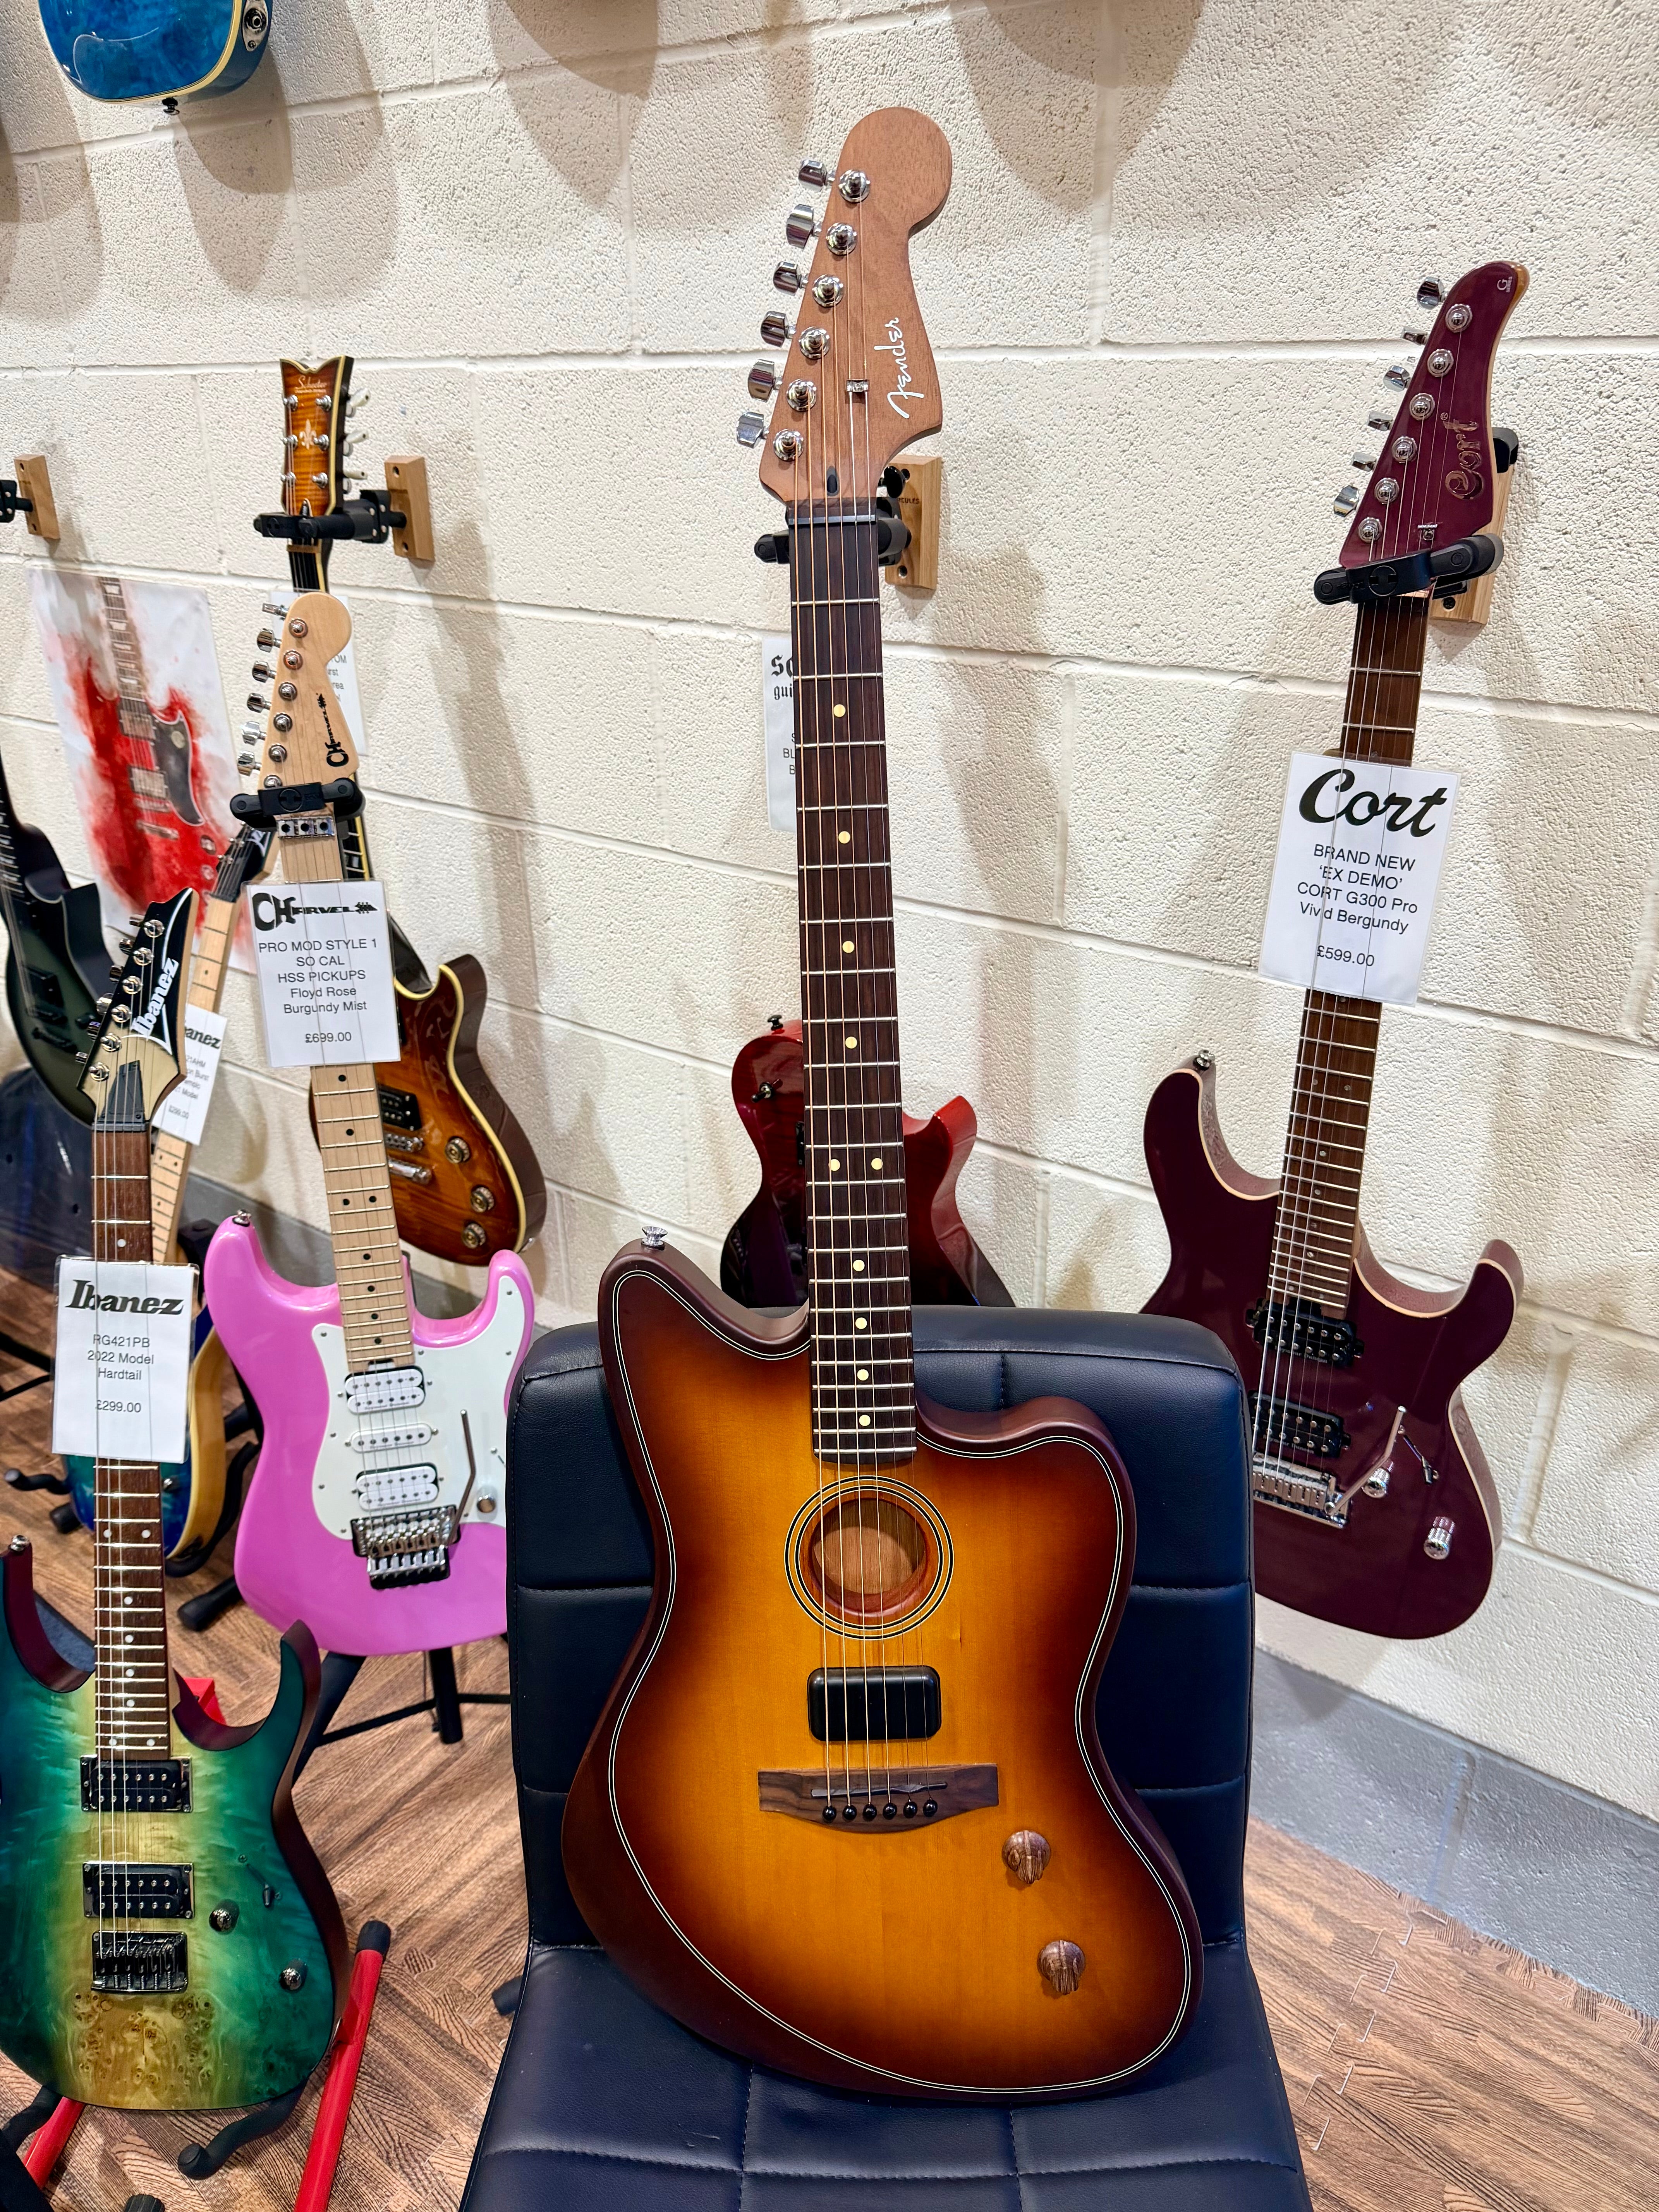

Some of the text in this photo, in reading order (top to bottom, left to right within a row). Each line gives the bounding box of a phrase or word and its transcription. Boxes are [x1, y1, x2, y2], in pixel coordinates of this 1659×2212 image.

[874, 317, 924, 419] Fender
[1443, 419, 1484, 500] Cort
[1299, 769, 1448, 837] Cort
[1314, 844, 1416, 871] BRAND NEW
[1297, 882, 1418, 914] CORT G300 Pro
[1300, 901, 1409, 935] Vivd Bergundy
[259, 938, 377, 953] PRO MOD STYLE 1
[296, 955, 345, 967] SO CAL
[1317, 945, 1375, 967] £599.00
[278, 970, 366, 983] HSS PICKUPS
[130, 957, 179, 1038] Ibanez
[290, 987, 357, 999] Floyd Rose
[284, 1001, 367, 1015] Burgundy Mist
[185, 1026, 221, 1049] anez
[305, 1031, 352, 1043] £699.00
[65, 1279, 184, 1316] Ibanez
[93, 1334, 150, 1348] RG421PB
[87, 1350, 154, 1365] 2022 Model
[98, 1367, 142, 1381] Hardtail
[96, 1400, 142, 1413] £299.00
